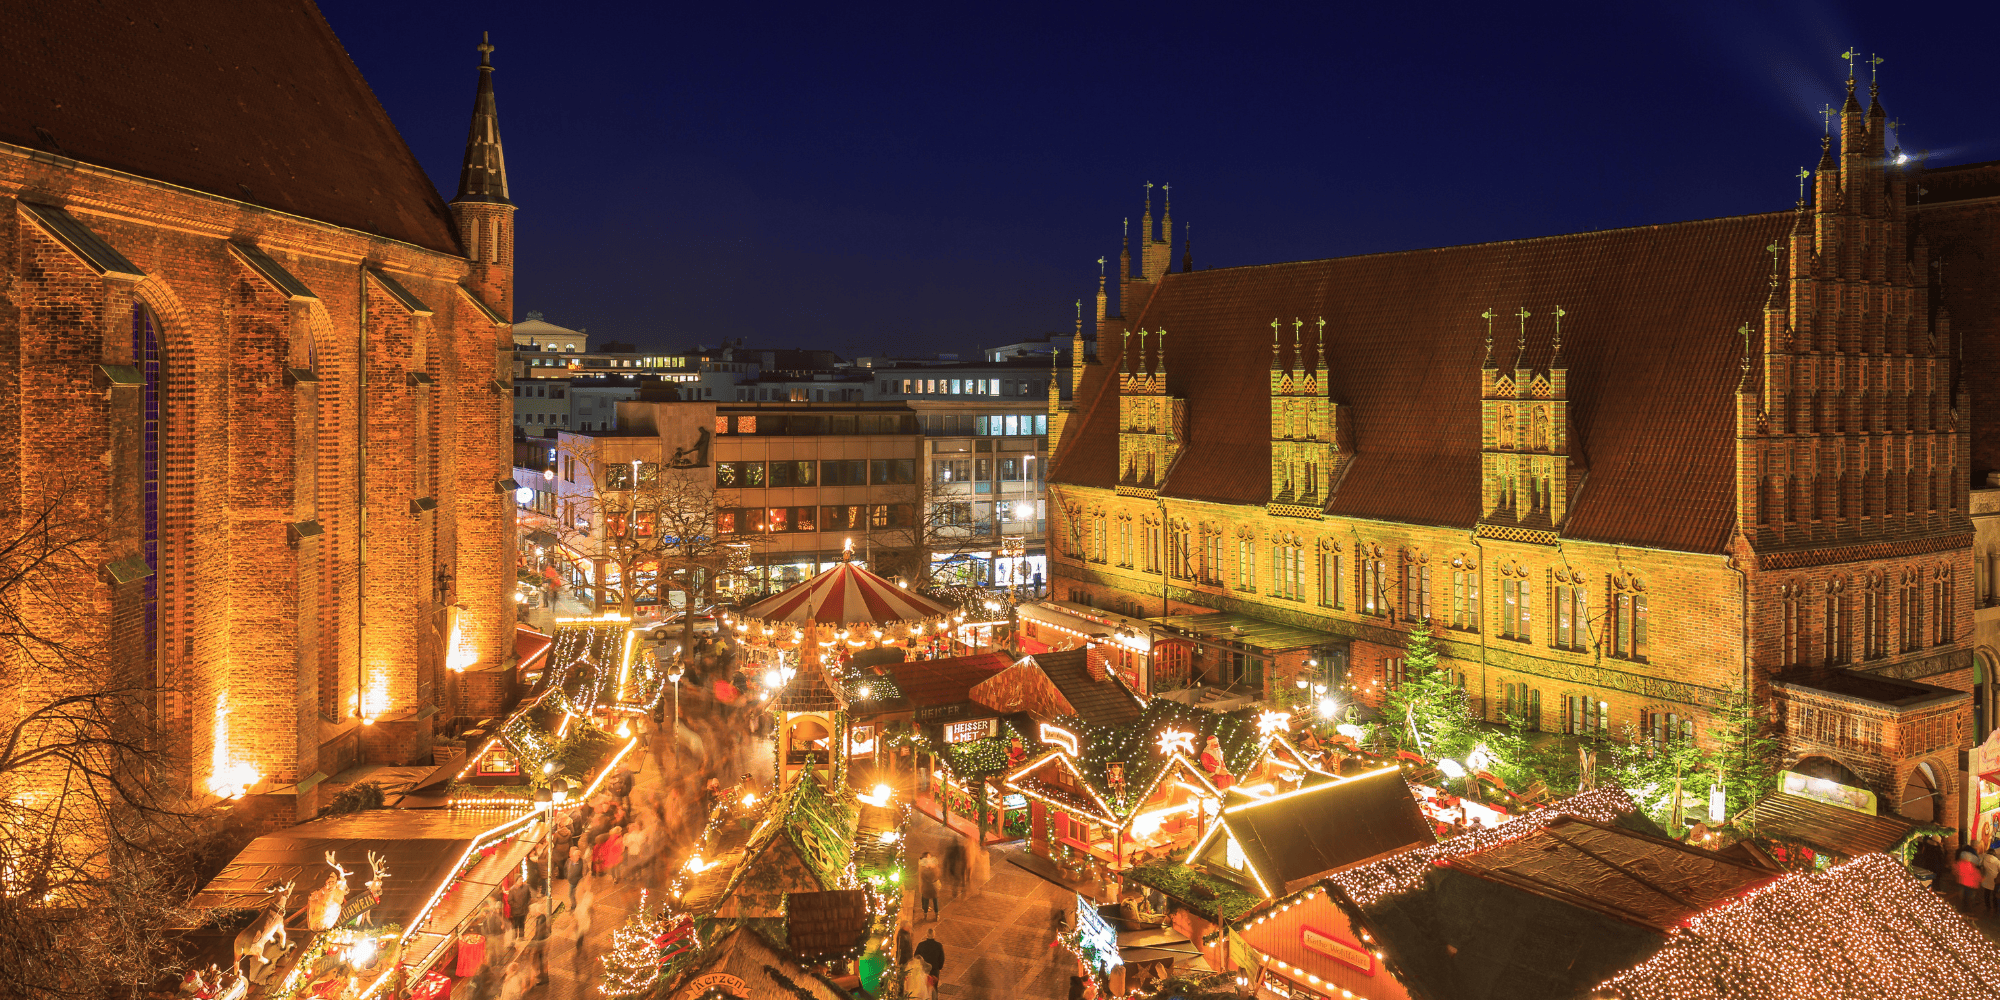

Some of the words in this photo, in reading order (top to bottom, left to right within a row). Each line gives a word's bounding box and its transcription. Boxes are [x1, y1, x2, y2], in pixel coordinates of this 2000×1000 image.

[954, 720, 988, 734] HEISSER
[959, 731, 979, 743] MET
[692, 975, 743, 991] Kerzen
